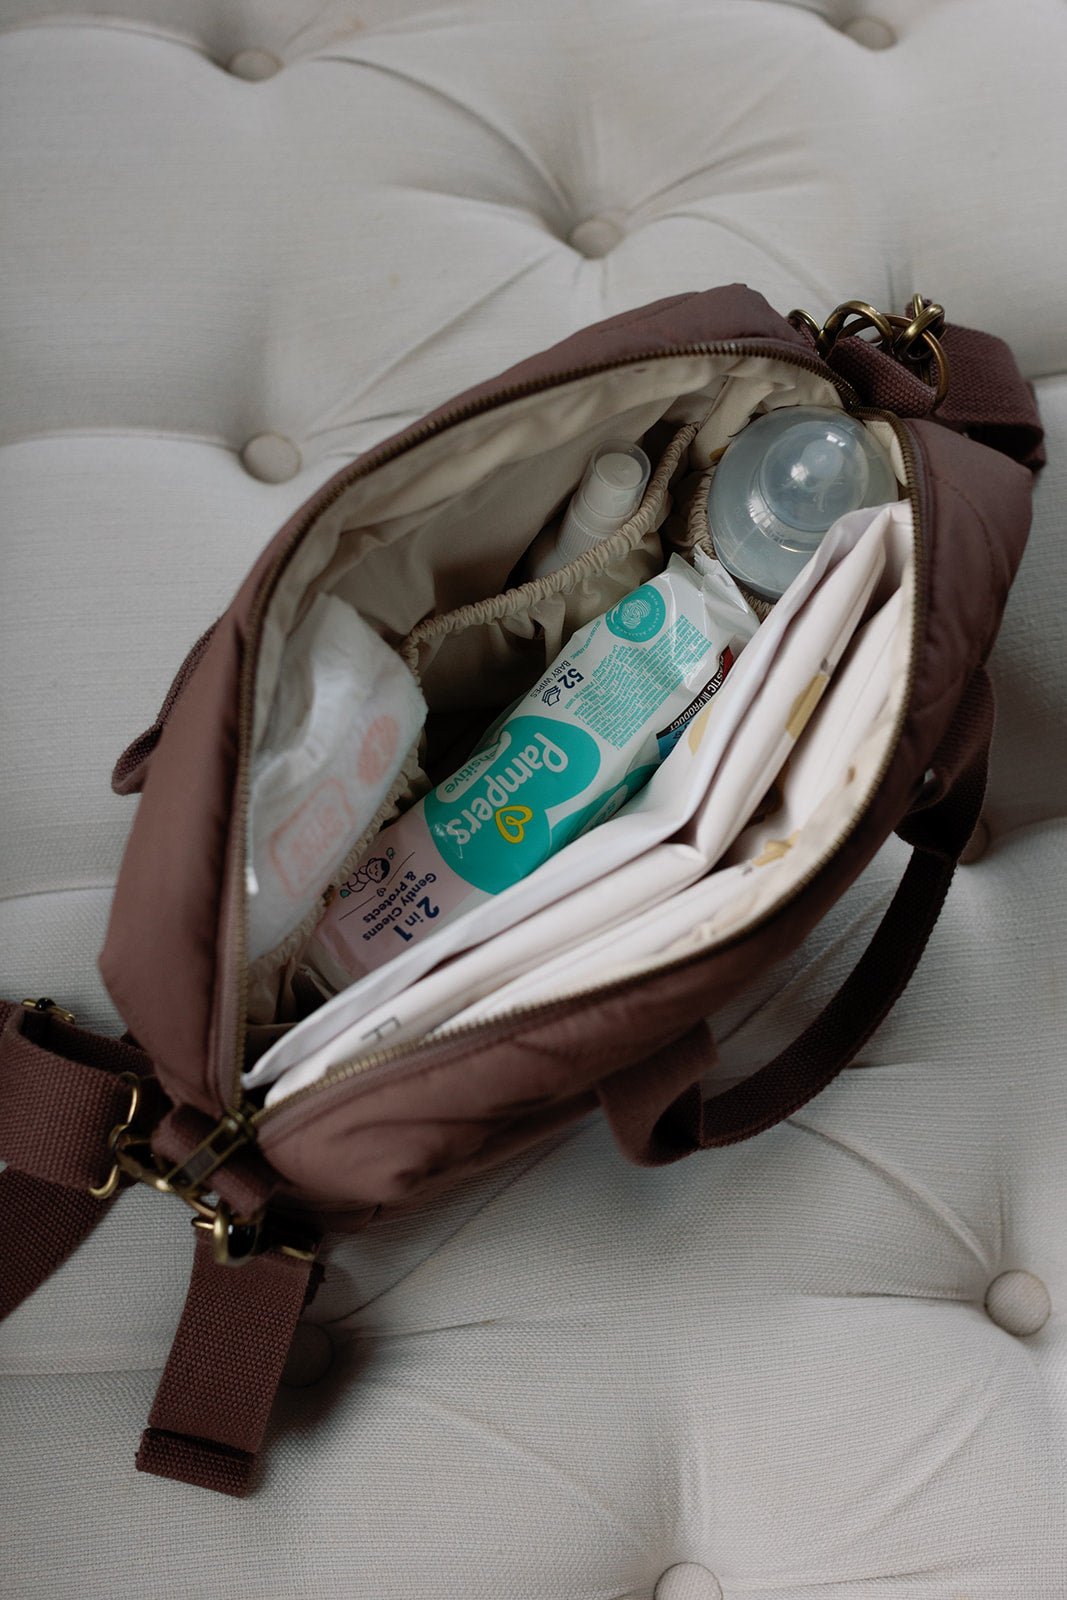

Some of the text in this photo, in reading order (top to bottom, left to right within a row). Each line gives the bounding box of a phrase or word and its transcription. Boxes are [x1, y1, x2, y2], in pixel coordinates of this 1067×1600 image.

[530, 660, 571, 698] BABY WIPES
[557, 668, 584, 689] 52
[669, 698, 705, 732] PRODUCT
[446, 732, 569, 845] Pampers
[362, 871, 417, 923] & Protects
[362, 873, 437, 941] Gently Cleans
[393, 896, 440, 942] 2 in 1
